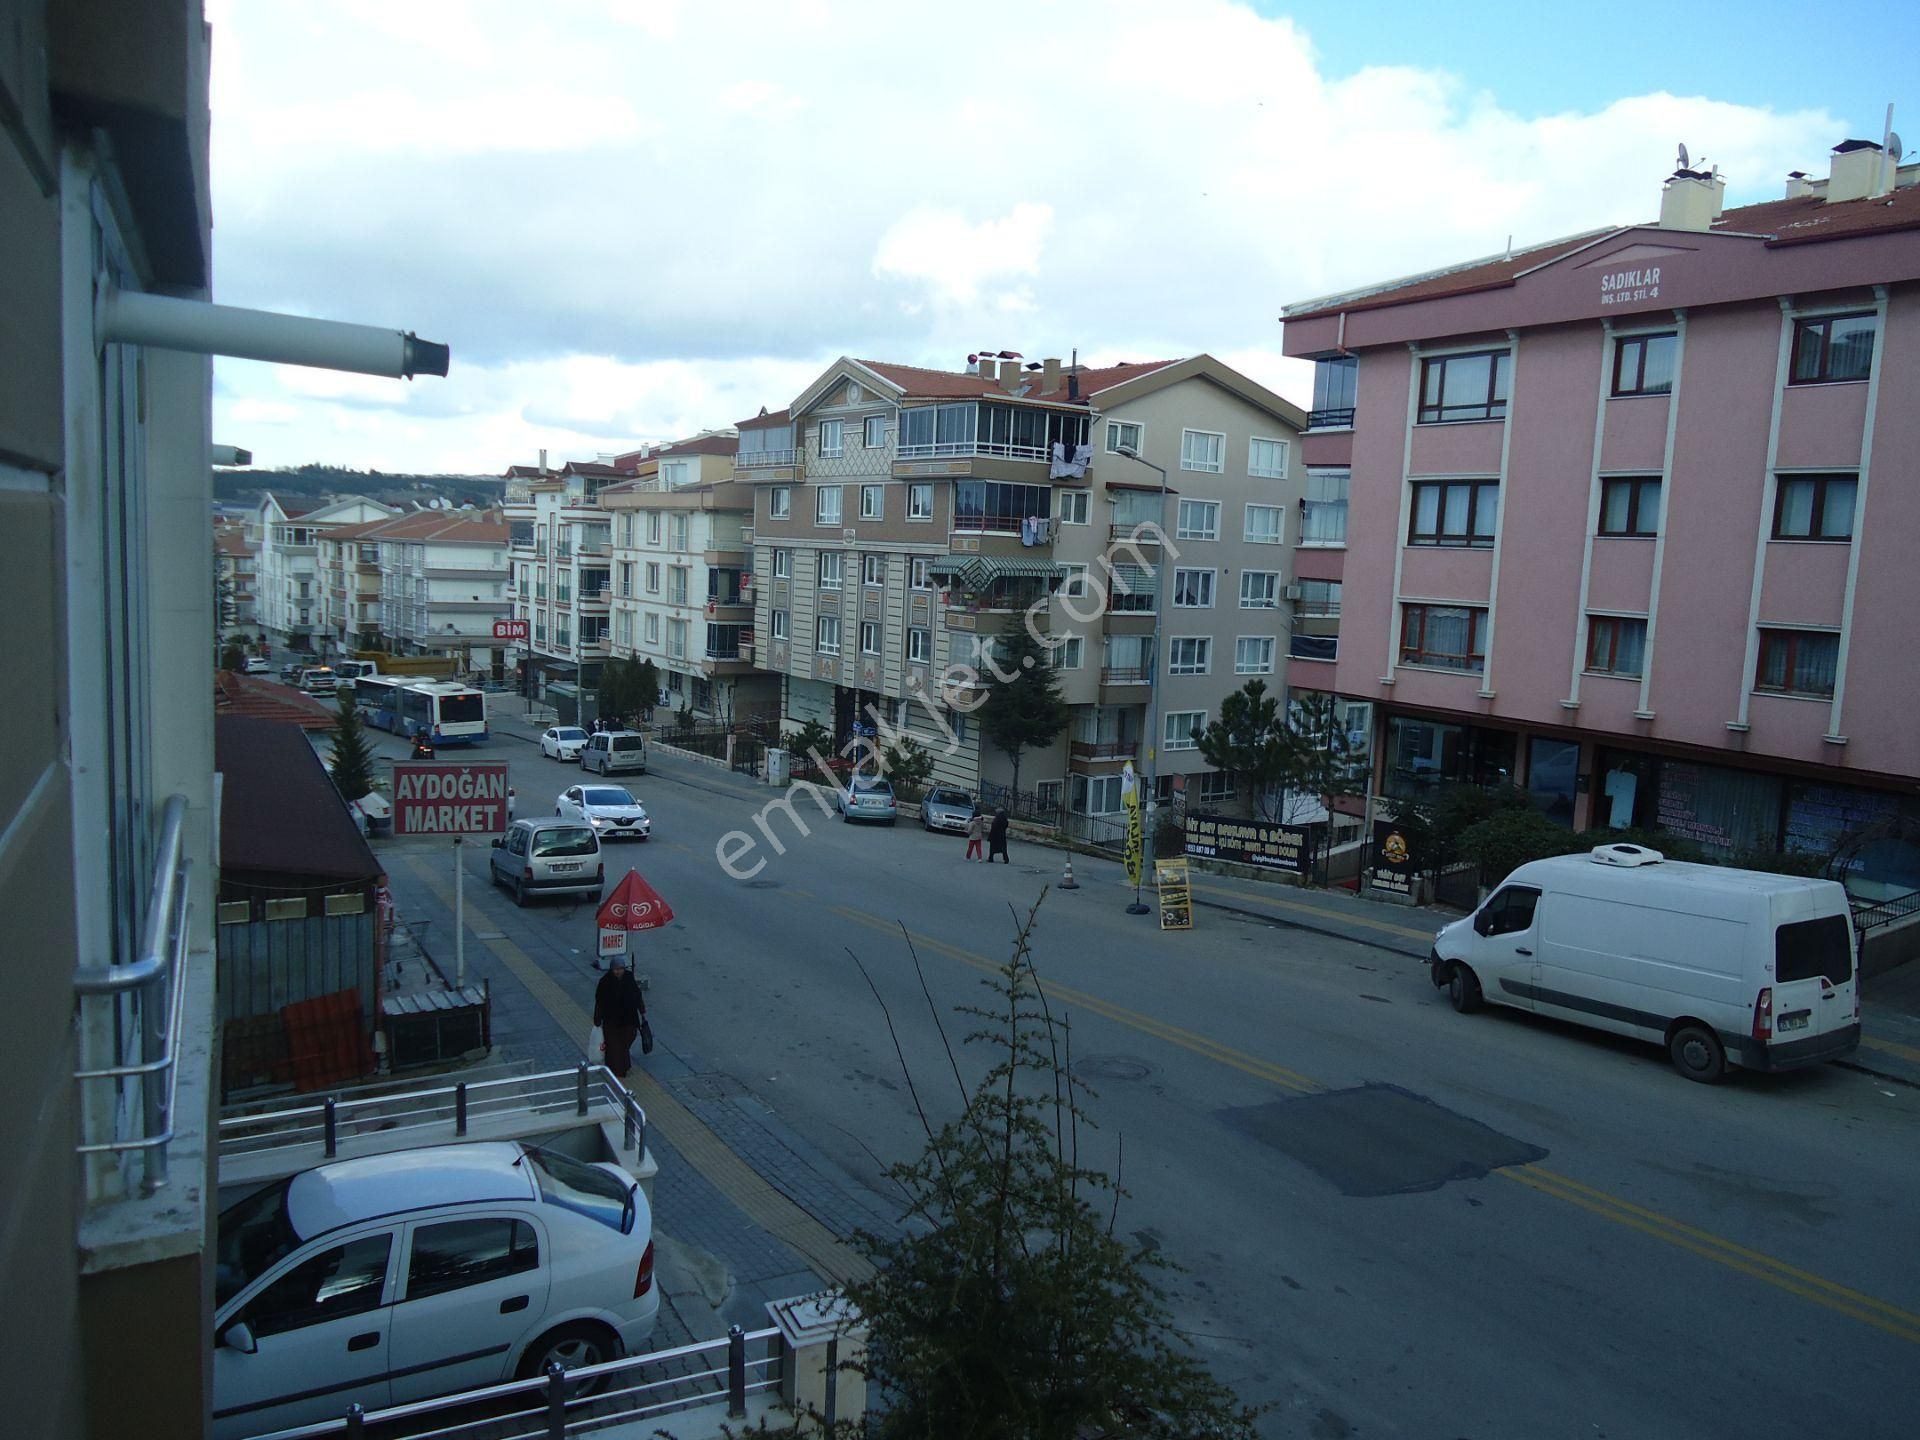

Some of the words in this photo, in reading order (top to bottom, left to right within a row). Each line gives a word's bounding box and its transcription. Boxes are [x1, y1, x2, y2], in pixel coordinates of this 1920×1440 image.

[1601, 268, 1660, 291] SADIKLAR
[1617, 291, 1632, 303] LTD.
[1649, 286, 1659, 298] 4
[496, 622, 525, 637] BİM
[396, 768, 506, 800] AYDOĞAN
[404, 805, 499, 833] MARKET
[603, 934, 624, 949] MARKET
